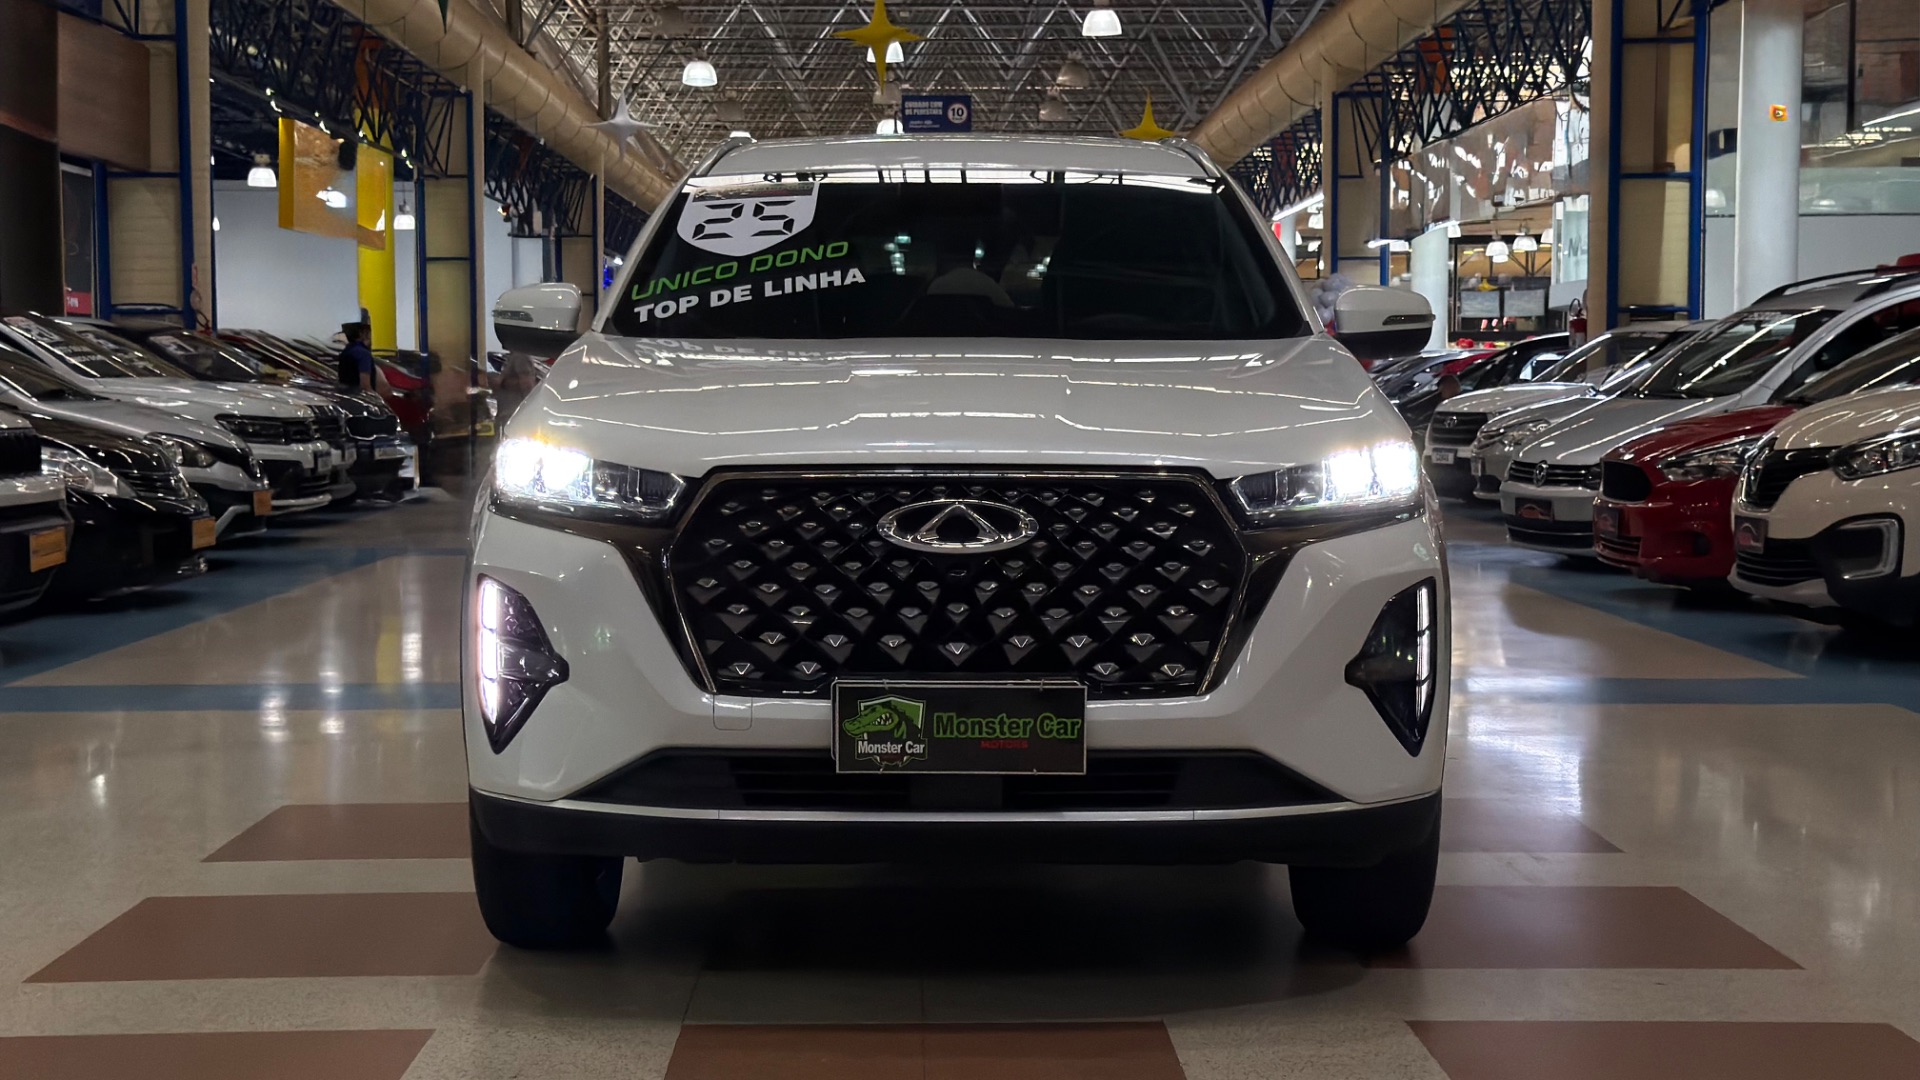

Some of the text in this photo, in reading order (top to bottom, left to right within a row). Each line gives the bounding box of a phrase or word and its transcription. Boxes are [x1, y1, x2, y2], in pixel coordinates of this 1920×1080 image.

[951, 107, 964, 117] 10
[692, 200, 796, 240] 25
[631, 241, 849, 301] UNICO DONO
[633, 267, 866, 323] TOP DE LINHA
[934, 712, 1082, 738] Monster Car
[858, 740, 925, 754] Monster Car
